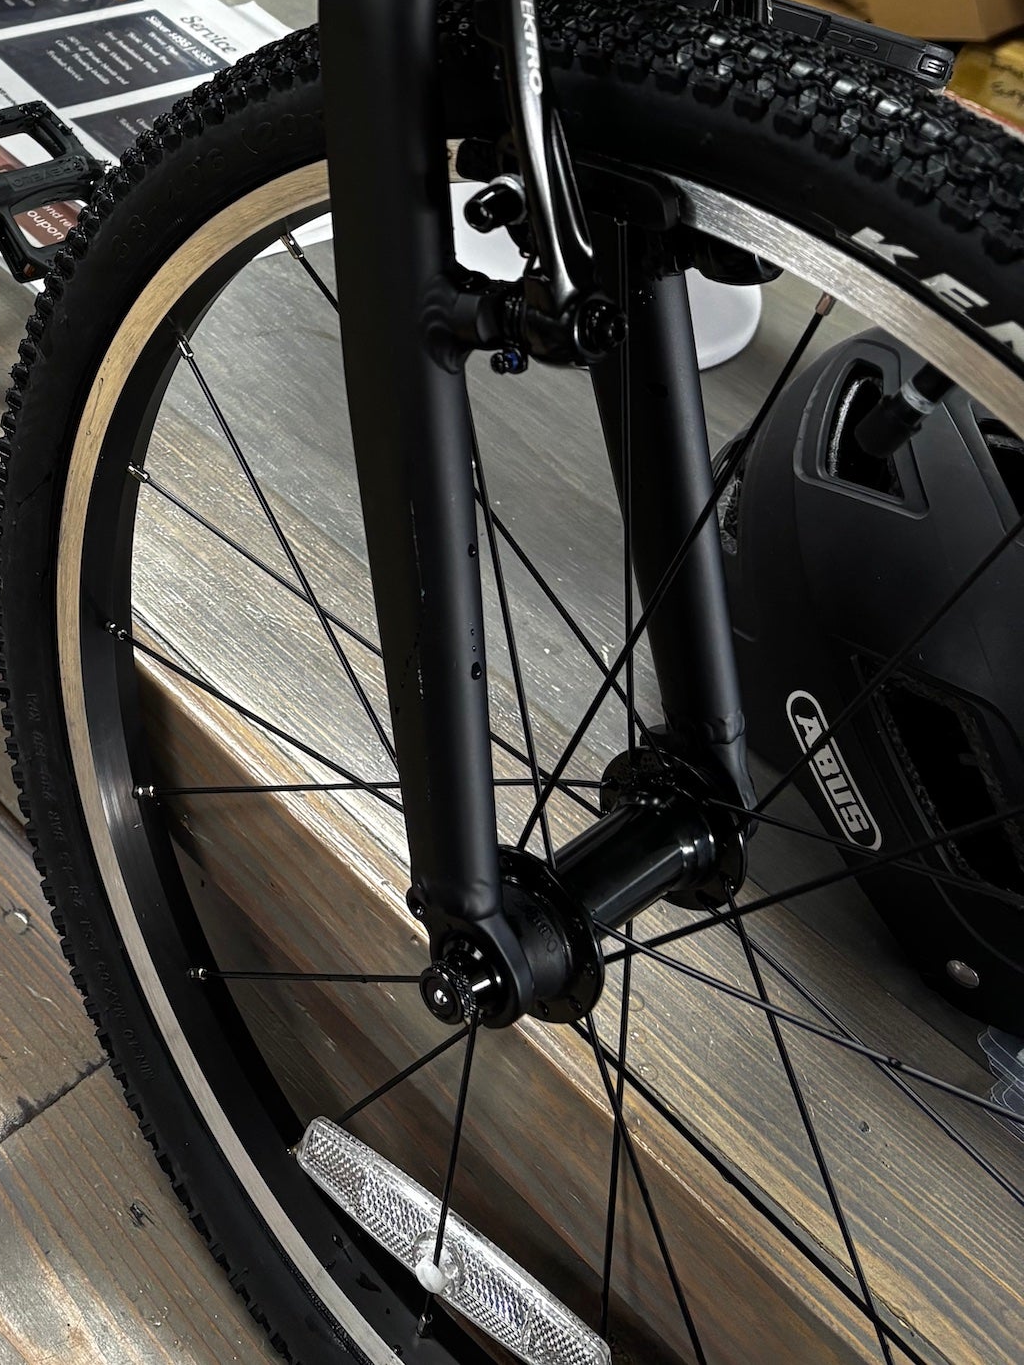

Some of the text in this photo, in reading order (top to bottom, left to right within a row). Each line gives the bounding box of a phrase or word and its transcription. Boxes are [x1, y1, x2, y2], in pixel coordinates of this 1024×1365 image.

[180, 16, 238, 53] Service
[26, 210, 65, 240] oupon
[794, 714, 870, 833] ABUS
